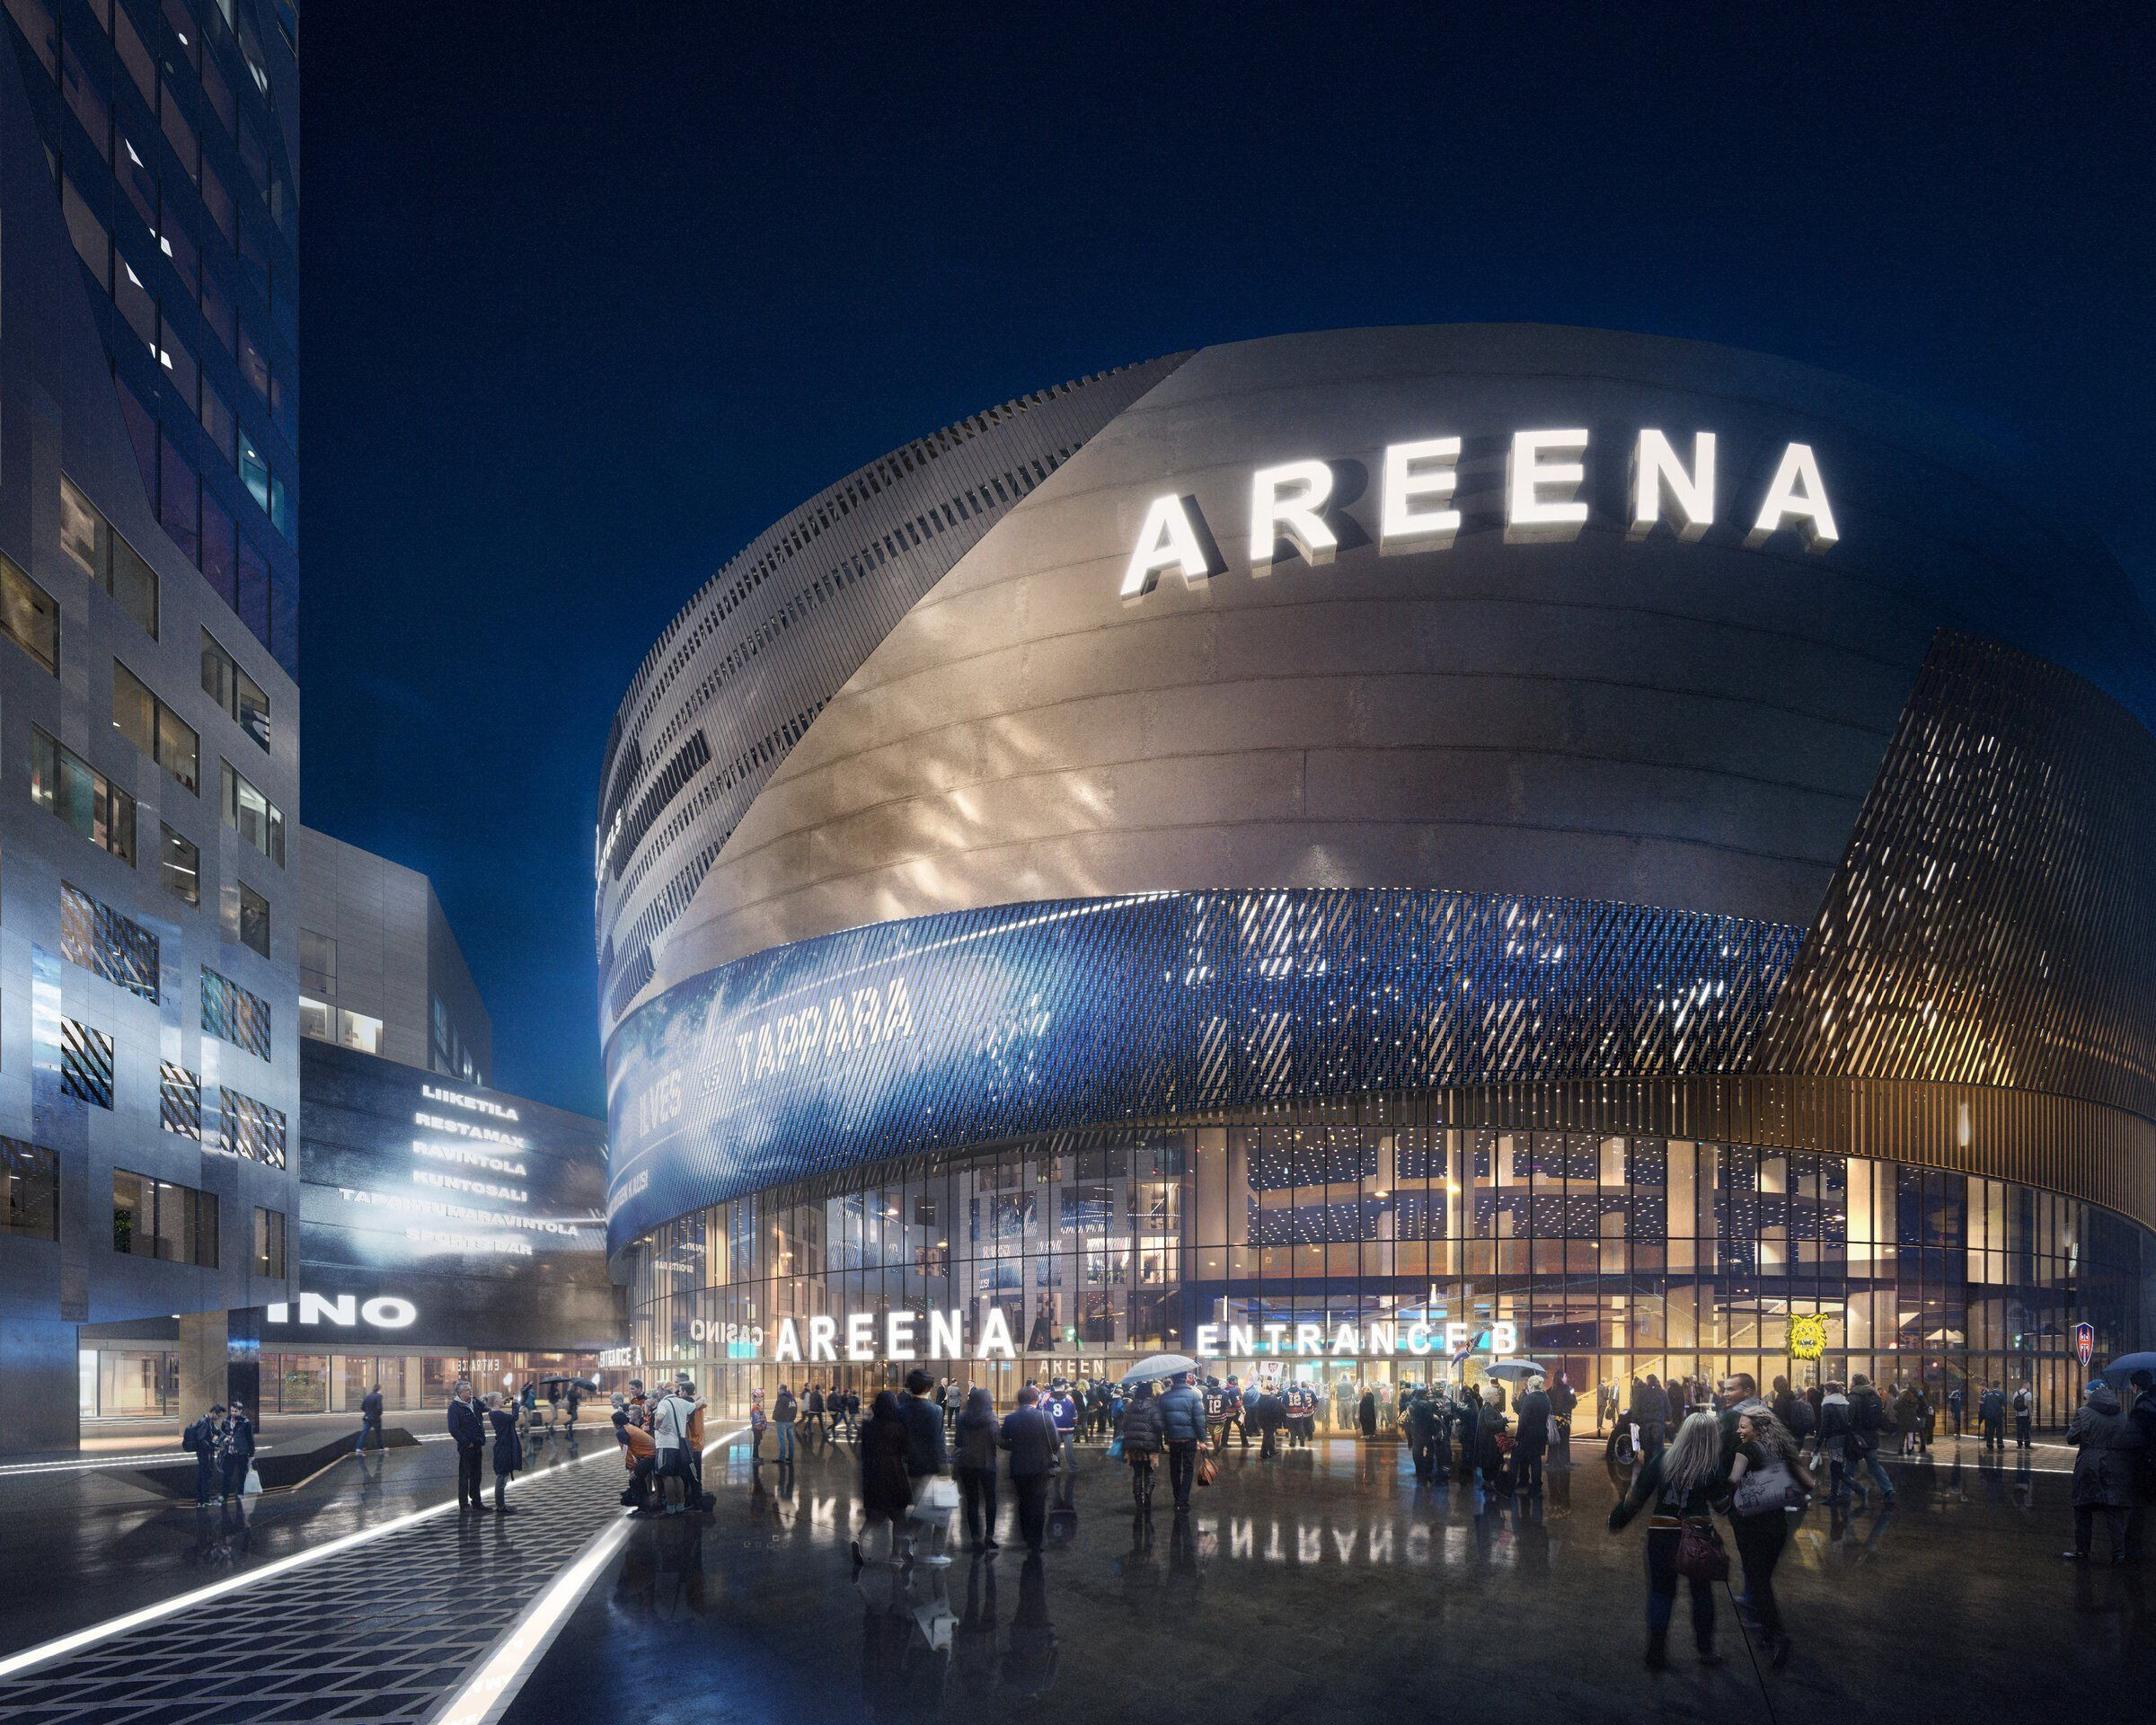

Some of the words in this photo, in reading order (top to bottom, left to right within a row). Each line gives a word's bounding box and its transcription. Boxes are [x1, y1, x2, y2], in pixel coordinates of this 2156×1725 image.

[1119, 429, 1839, 597] AREENA
[736, 978, 915, 1085] TAPPARA
[422, 1084, 519, 1121] LIIKETILA
[415, 1113, 525, 1148] RESTAMAX
[413, 1141, 526, 1176] RAVINTOLA
[412, 1171, 527, 1202] KUNTOSALI
[494, 1239, 533, 1256] BAR
[774, 1308, 1017, 1360] AREENA
[1197, 1324, 1468, 1356] ENTRANCE
[1491, 1323, 1517, 1353] B
[1053, 1403, 1063, 1417] 8
